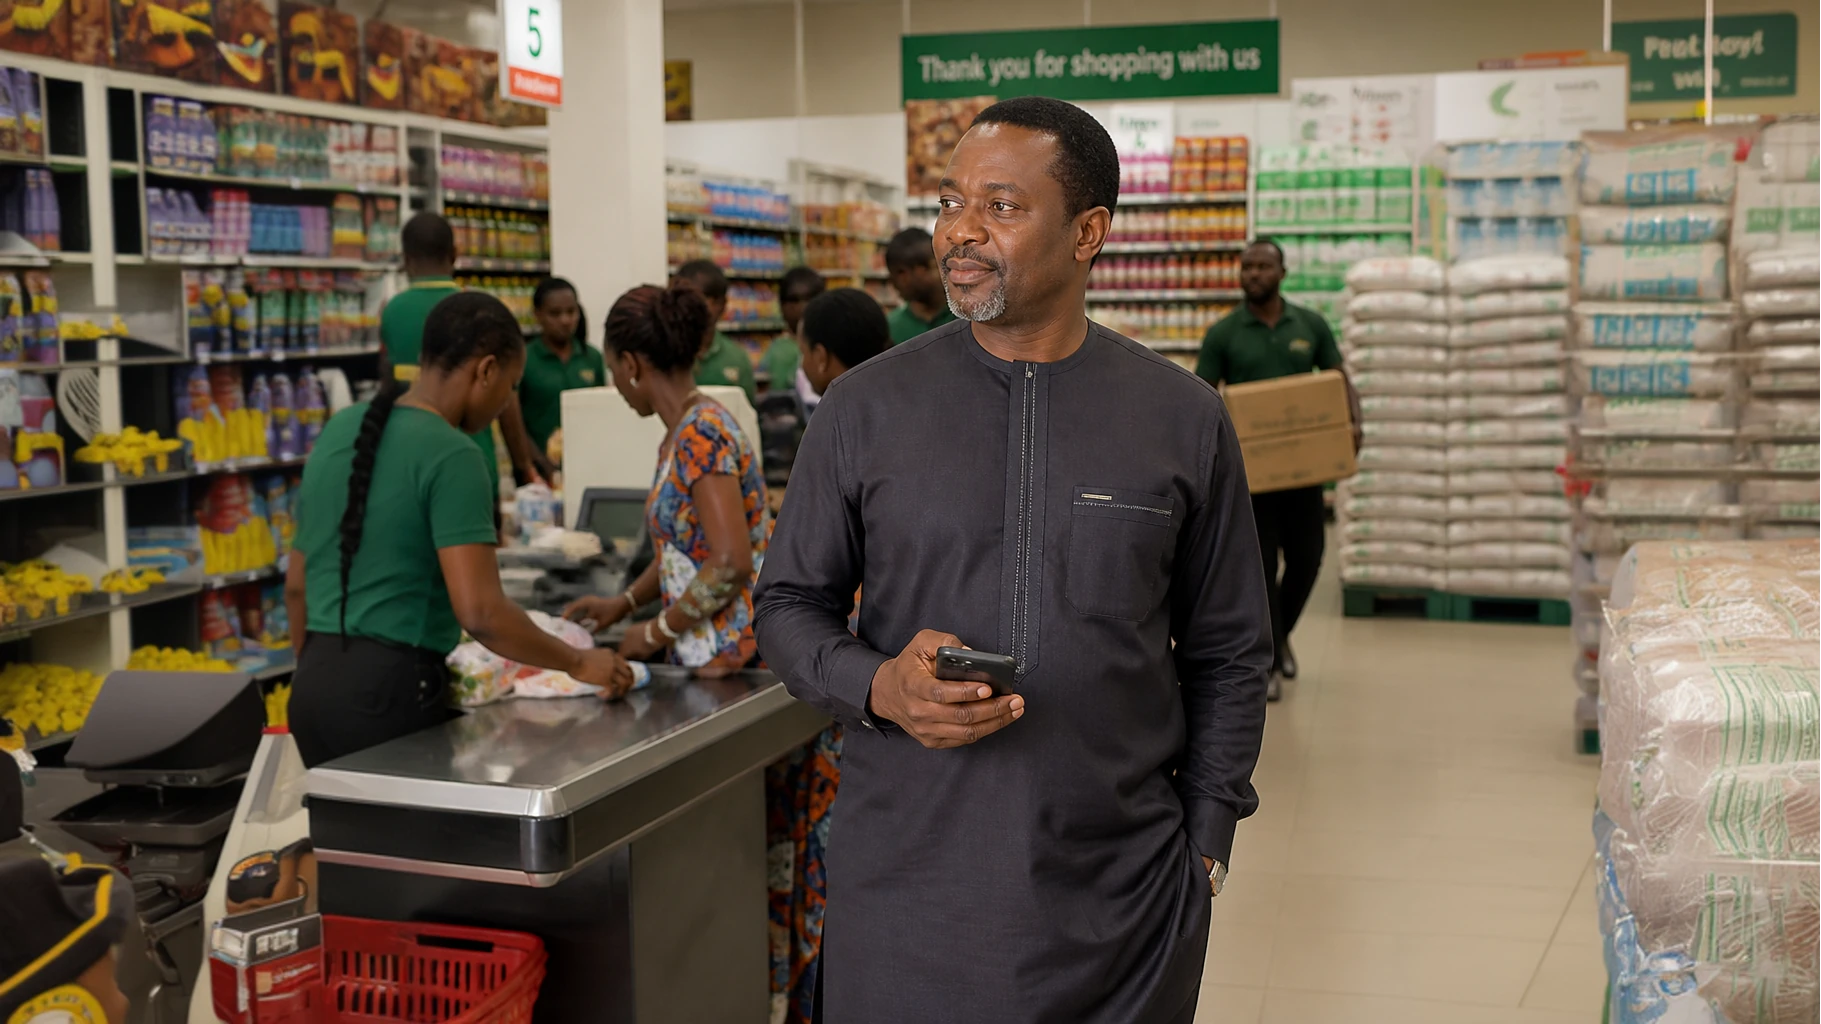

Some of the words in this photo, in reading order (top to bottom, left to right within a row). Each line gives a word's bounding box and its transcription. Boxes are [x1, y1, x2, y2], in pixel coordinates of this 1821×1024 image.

[527, 6, 542, 57] 5
[917, 52, 986, 83] Thank
[988, 57, 1031, 87] you
[1034, 49, 1068, 78] for
[1070, 45, 1174, 82] shopping
[1177, 42, 1229, 73] with
[1232, 47, 1262, 71] us
